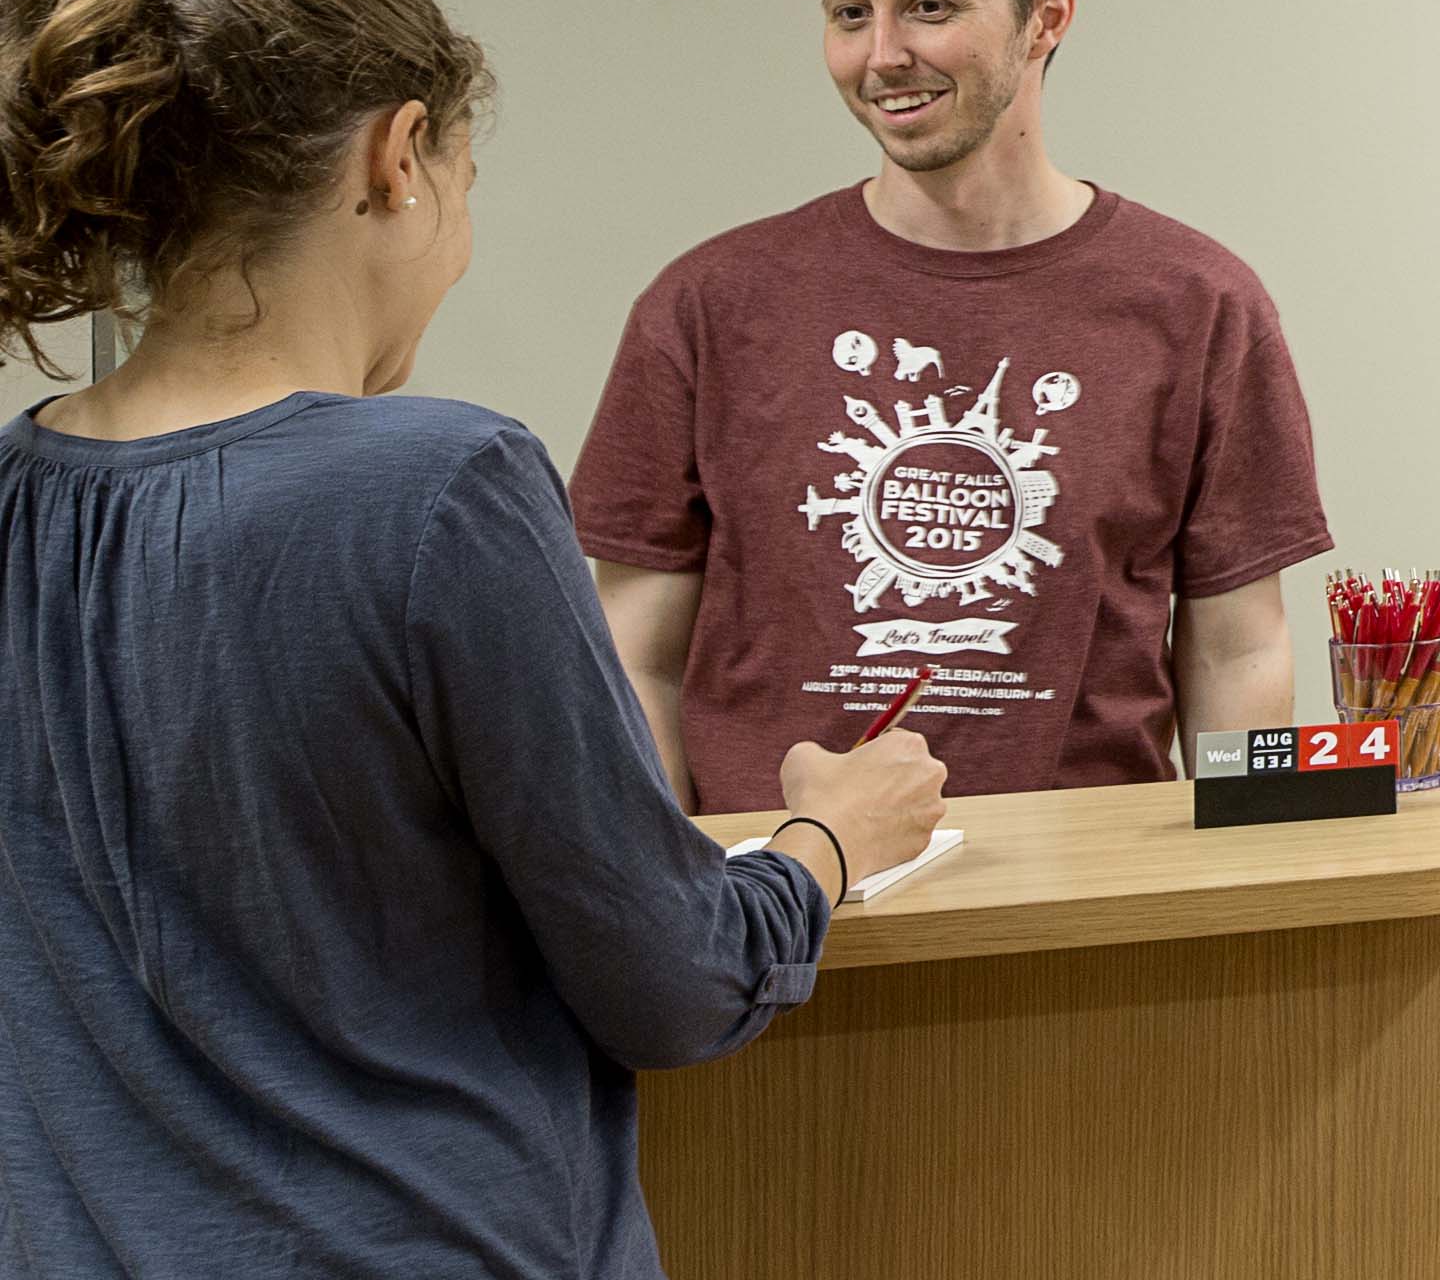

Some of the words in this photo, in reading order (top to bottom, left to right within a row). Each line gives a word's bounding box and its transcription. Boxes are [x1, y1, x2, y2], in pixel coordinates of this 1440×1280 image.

[894, 466, 953, 484] GREAT
[954, 473, 1005, 487] FALLS
[883, 480, 1011, 508] BALLOON
[880, 500, 1009, 529] FESTIVAL
[904, 525, 985, 552] 2015
[876, 628, 921, 648] Let's
[927, 628, 995, 644] Travel!
[859, 666, 921, 679] ANNUAL
[801, 681, 838, 693] AUGUST
[878, 683, 908, 694] 2015
[1206, 748, 1242, 764] Wed
[1252, 732, 1293, 748] AUG
[1252, 754, 1293, 770] FEB
